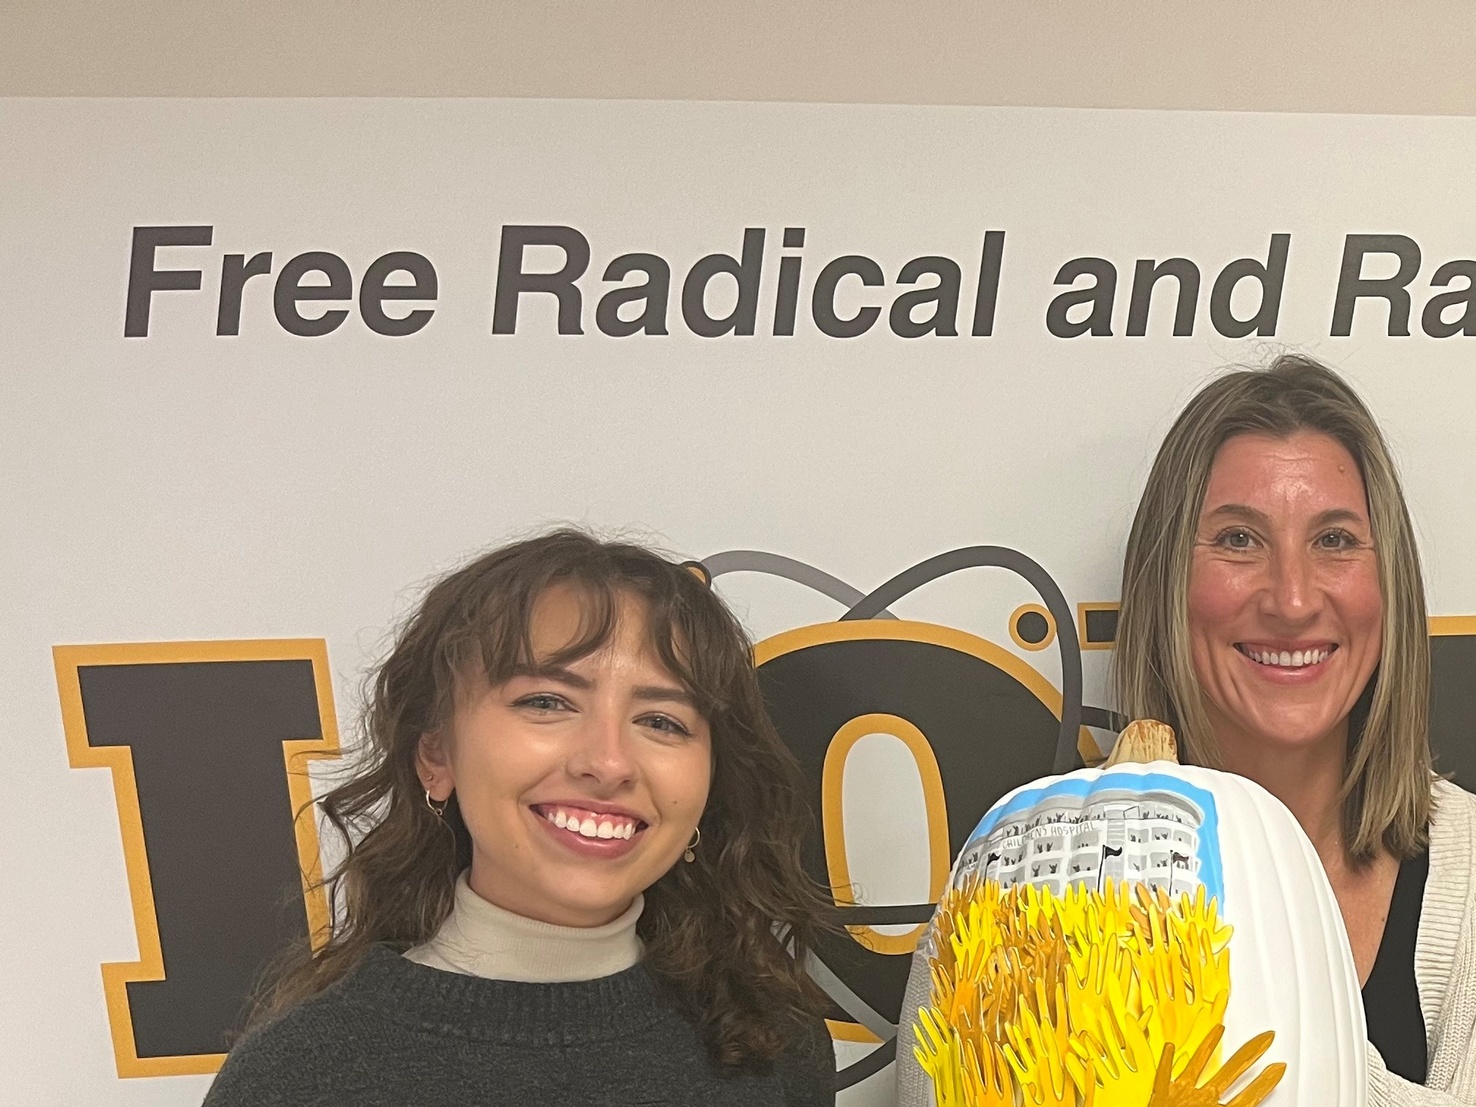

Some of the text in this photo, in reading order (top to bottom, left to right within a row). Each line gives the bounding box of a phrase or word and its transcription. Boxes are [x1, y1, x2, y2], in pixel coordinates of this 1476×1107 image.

[124, 225, 438, 338] Free
[491, 225, 1006, 339] Radical
[1045, 233, 1292, 339] and
[1050, 821, 1096, 836] HOSPITAL
